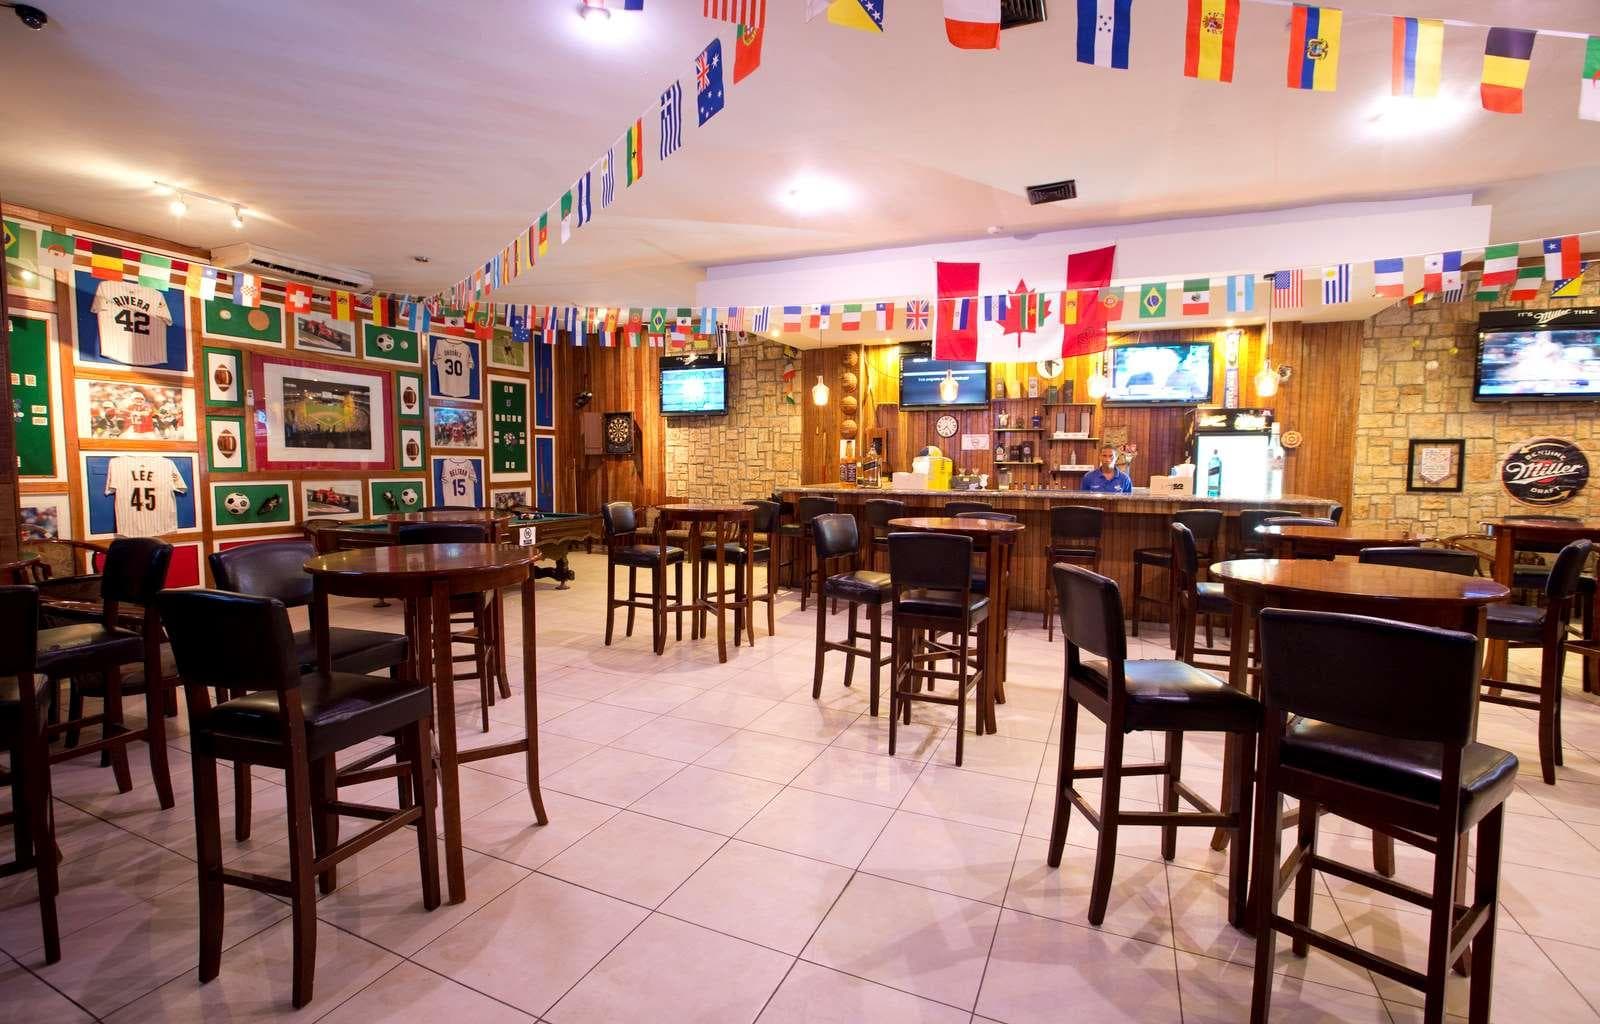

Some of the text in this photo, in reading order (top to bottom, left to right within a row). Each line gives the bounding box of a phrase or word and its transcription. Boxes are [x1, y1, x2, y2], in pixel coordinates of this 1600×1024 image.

[113, 295, 150, 311] RIVERA
[114, 309, 150, 335] 42
[1533, 308, 1571, 325] Miller
[444, 358, 463, 377] 30
[1525, 450, 1567, 461] GENUINE
[131, 470, 154, 482] LEE
[1505, 462, 1583, 485] Miller
[452, 479, 466, 496] 15
[1530, 485, 1560, 494] DRAFT
[130, 487, 156, 511] 45
